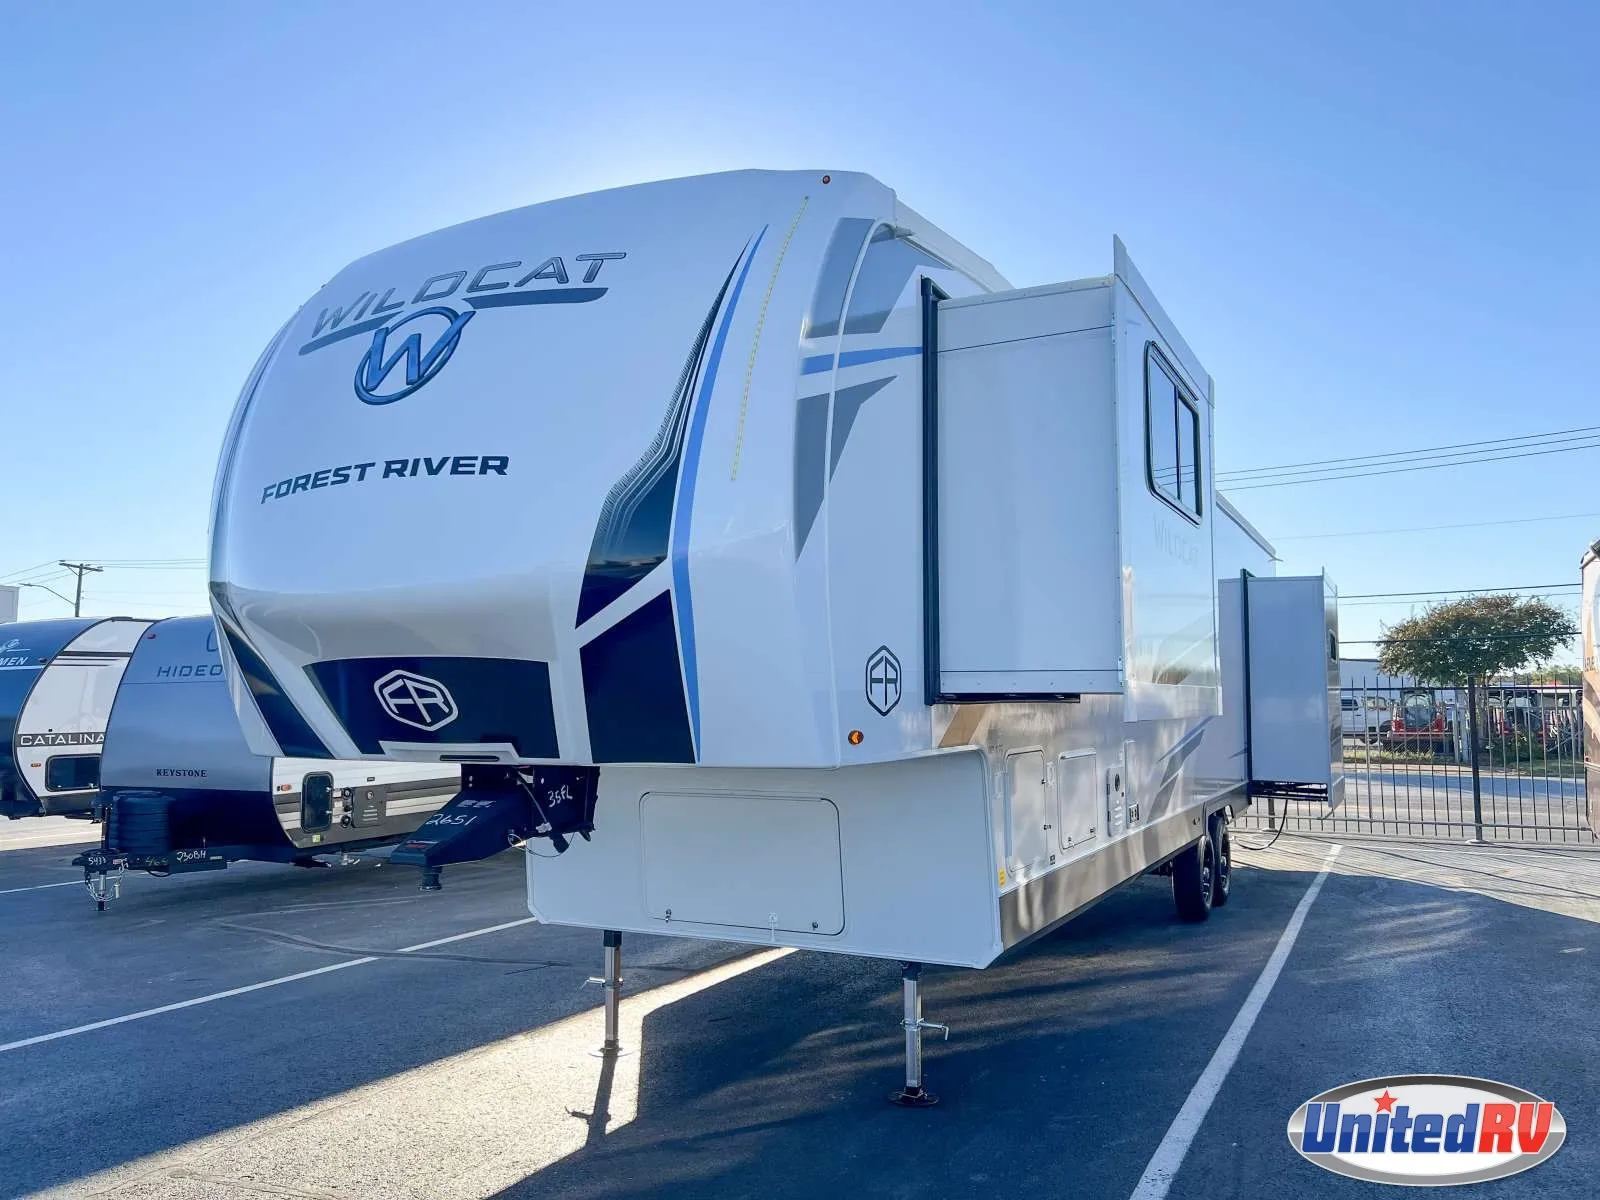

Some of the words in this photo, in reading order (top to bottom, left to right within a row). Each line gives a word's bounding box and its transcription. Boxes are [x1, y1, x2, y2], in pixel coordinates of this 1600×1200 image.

[312, 252, 627, 339] WILDCAT
[261, 462, 376, 504] FOREST
[382, 456, 510, 479] RIVER
[20, 733, 105, 746] CATALINA
[156, 768, 208, 778] KEYSTONE
[425, 813, 478, 826] 2651
